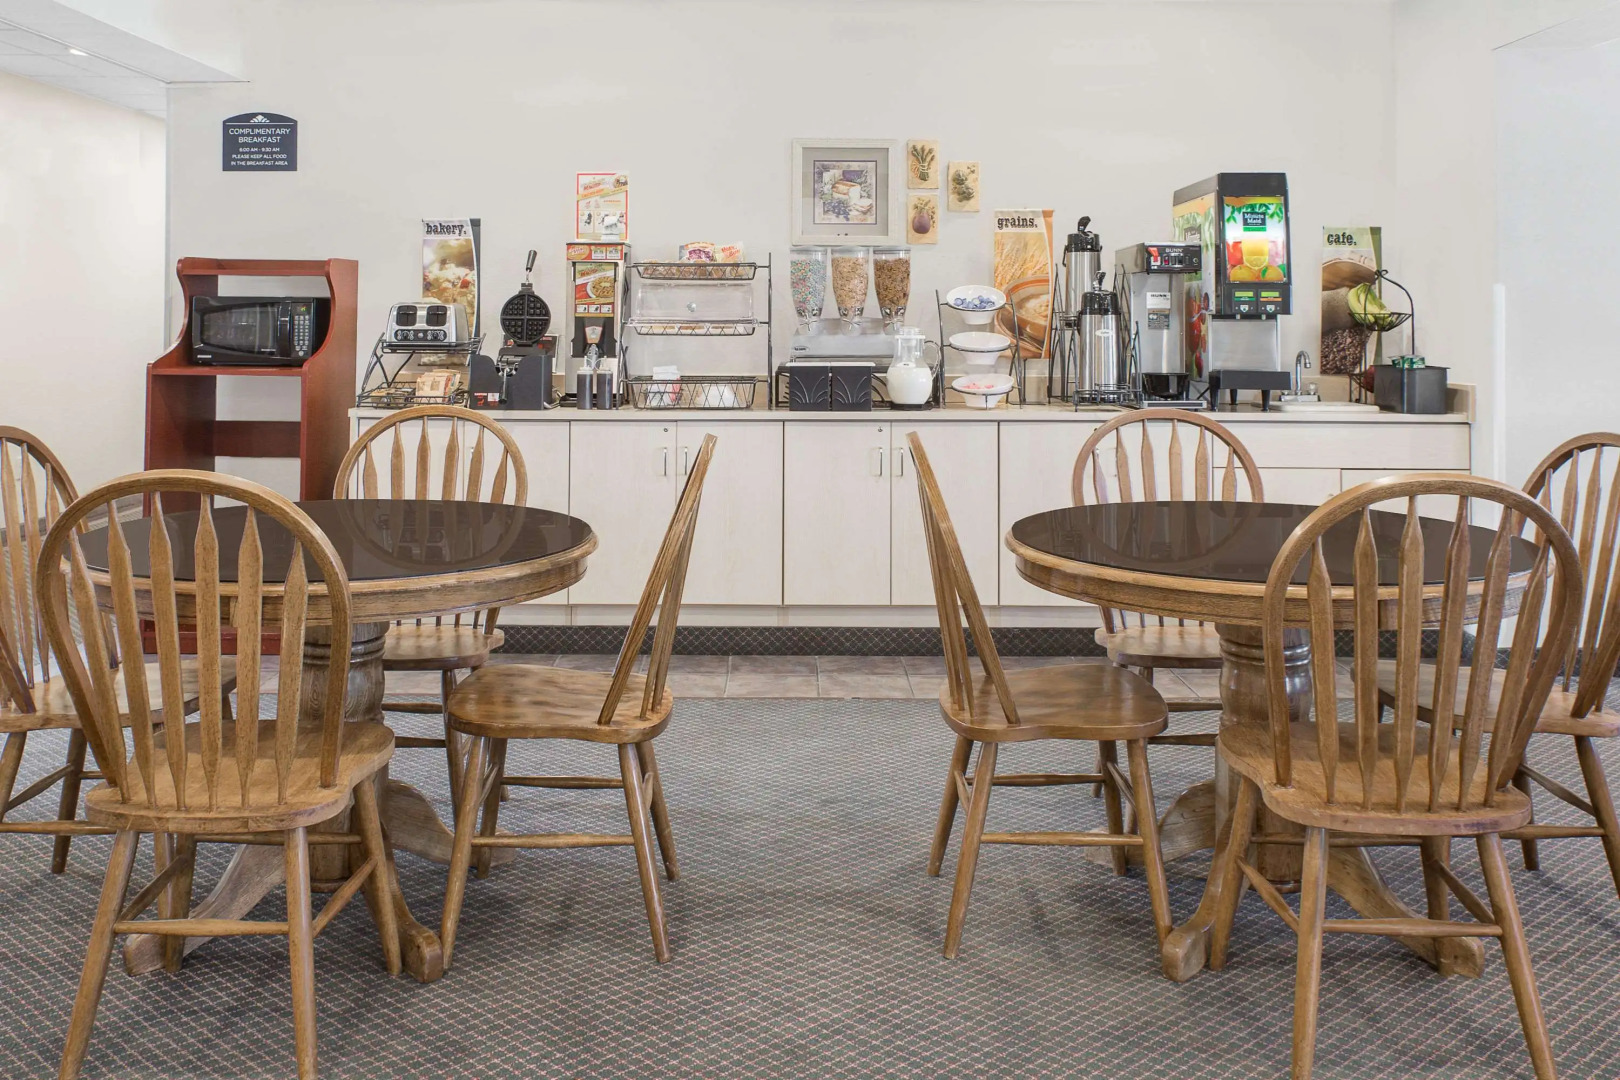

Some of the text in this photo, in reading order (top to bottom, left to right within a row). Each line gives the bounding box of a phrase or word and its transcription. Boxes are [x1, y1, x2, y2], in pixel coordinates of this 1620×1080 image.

[425, 222, 467, 236] bakery.
[997, 215, 1038, 230] grains.
[1327, 231, 1357, 245] cafe.
